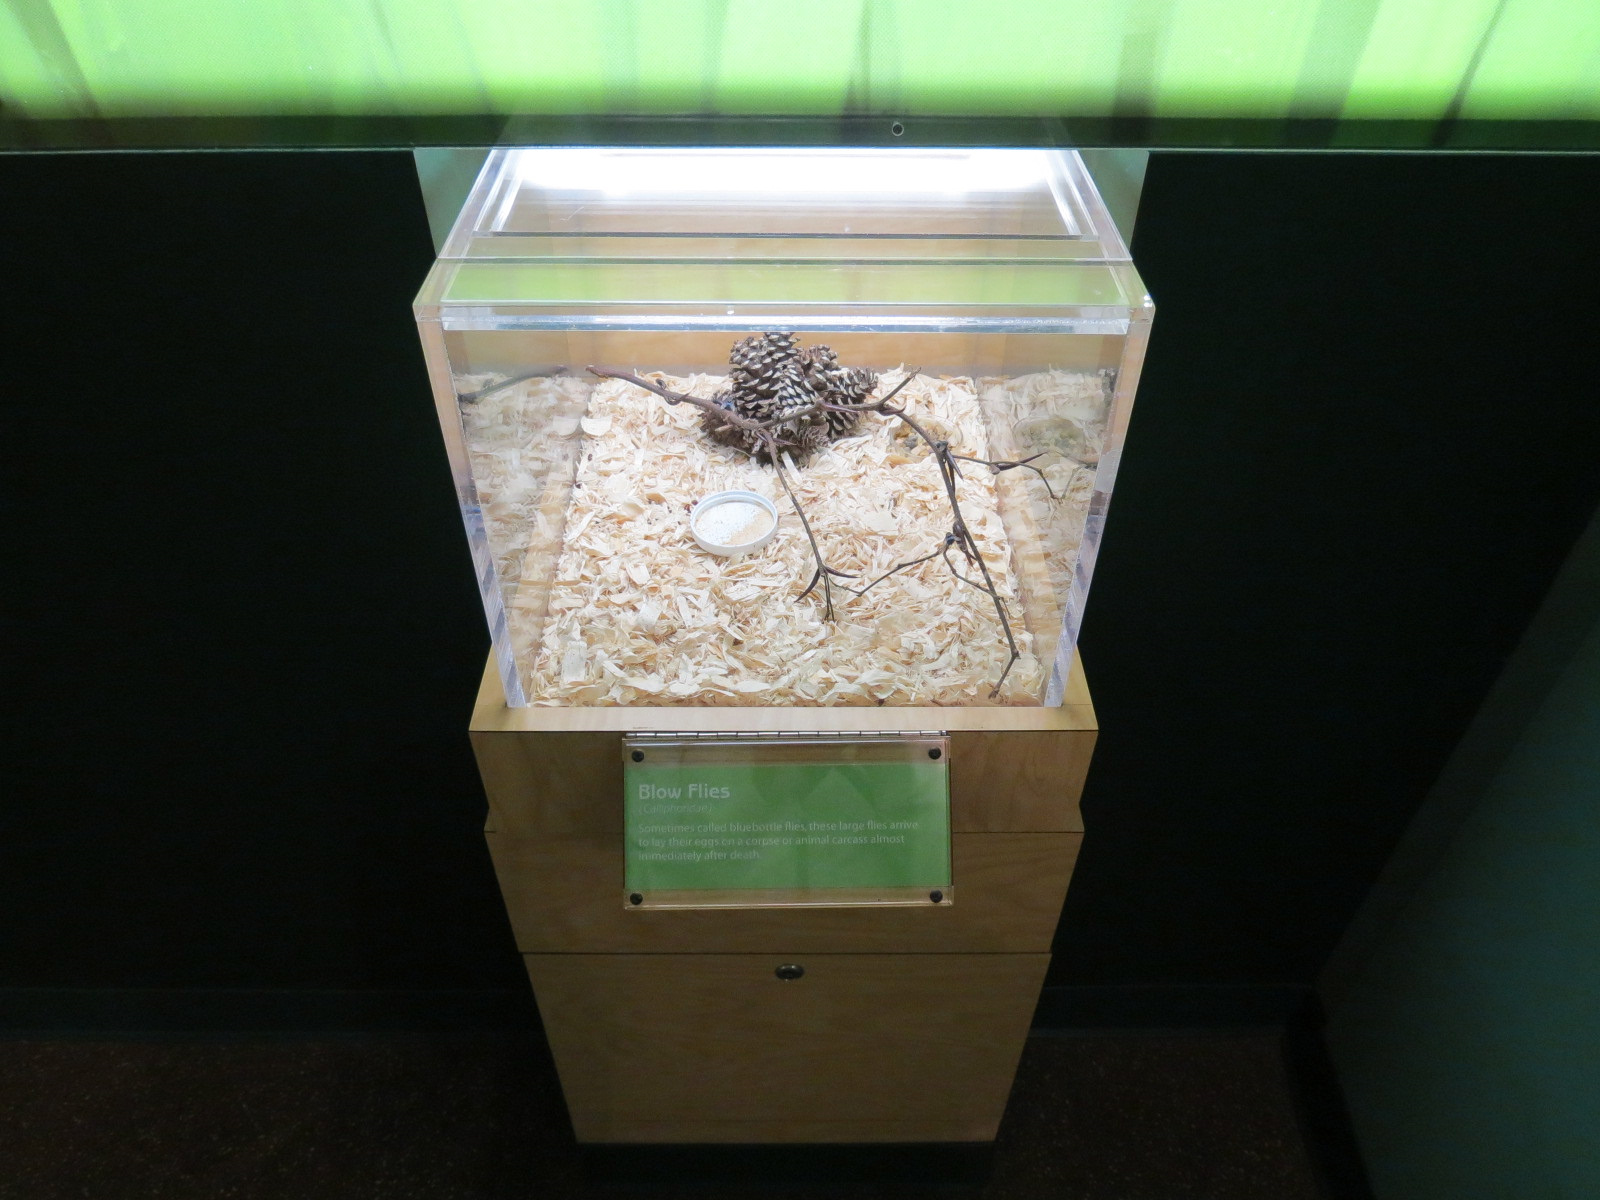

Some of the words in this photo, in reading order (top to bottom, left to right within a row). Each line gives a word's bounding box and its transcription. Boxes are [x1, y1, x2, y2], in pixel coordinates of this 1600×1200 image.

[639, 784, 681, 800] Blow
[688, 783, 731, 799] Flies
[639, 824, 695, 833] Sometimes
[697, 823, 727, 833] called
[730, 822, 783, 832] bluebottle
[809, 821, 837, 831] these
[839, 821, 865, 832] large
[867, 820, 887, 830] flies
[890, 820, 918, 829] arrive
[639, 838, 649, 847] to
[652, 838, 665, 848] lay
[669, 837, 692, 846] their
[694, 839, 719, 848] eggs
[745, 838, 781, 847] corpse
[782, 837, 793, 845] or
[796, 835, 829, 845] animal
[832, 836, 868, 844] carcass
[871, 834, 905, 844] almost
[638, 851, 702, 862] immediately
[704, 850, 727, 860] after
